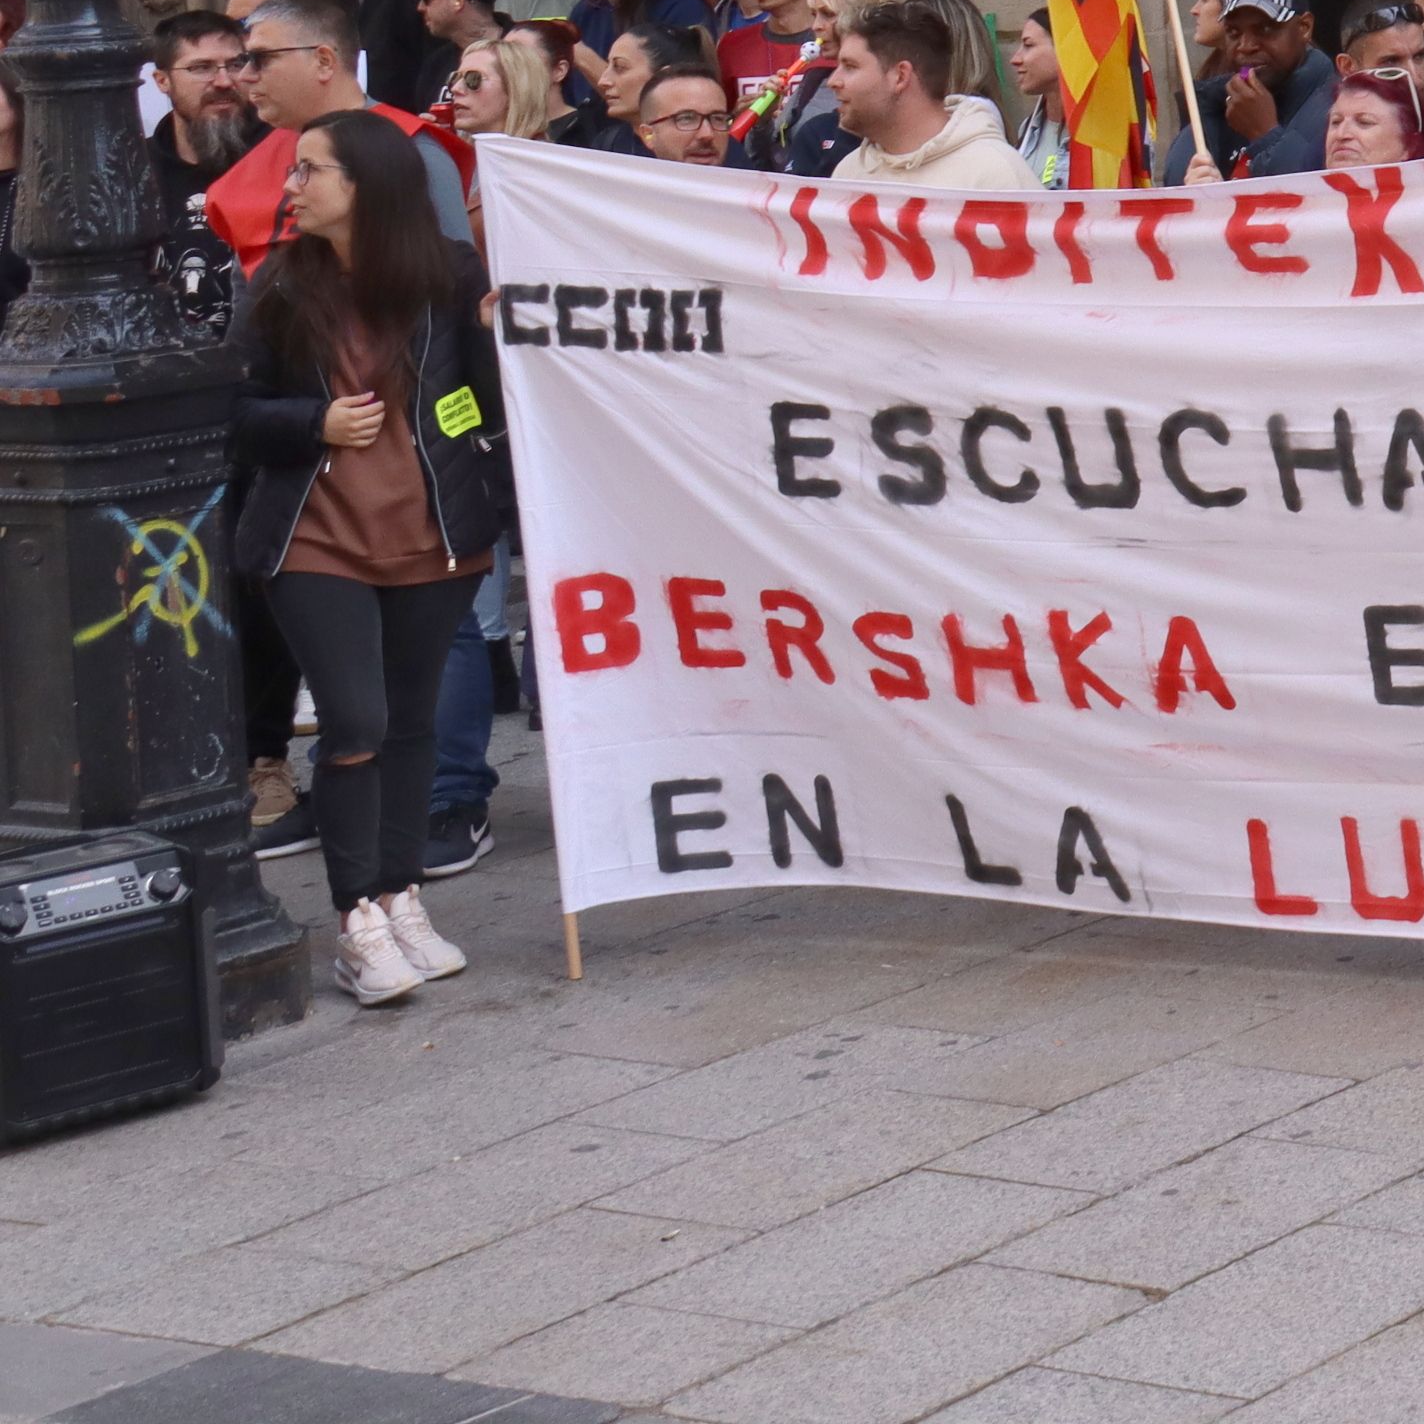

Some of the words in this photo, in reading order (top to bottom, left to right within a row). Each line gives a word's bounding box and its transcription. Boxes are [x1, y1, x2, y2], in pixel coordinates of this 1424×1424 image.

[500, 284, 724, 353] CCOO
[555, 571, 1236, 714] BERSHKA
[650, 773, 844, 873] EN
[945, 794, 1131, 903] LA
